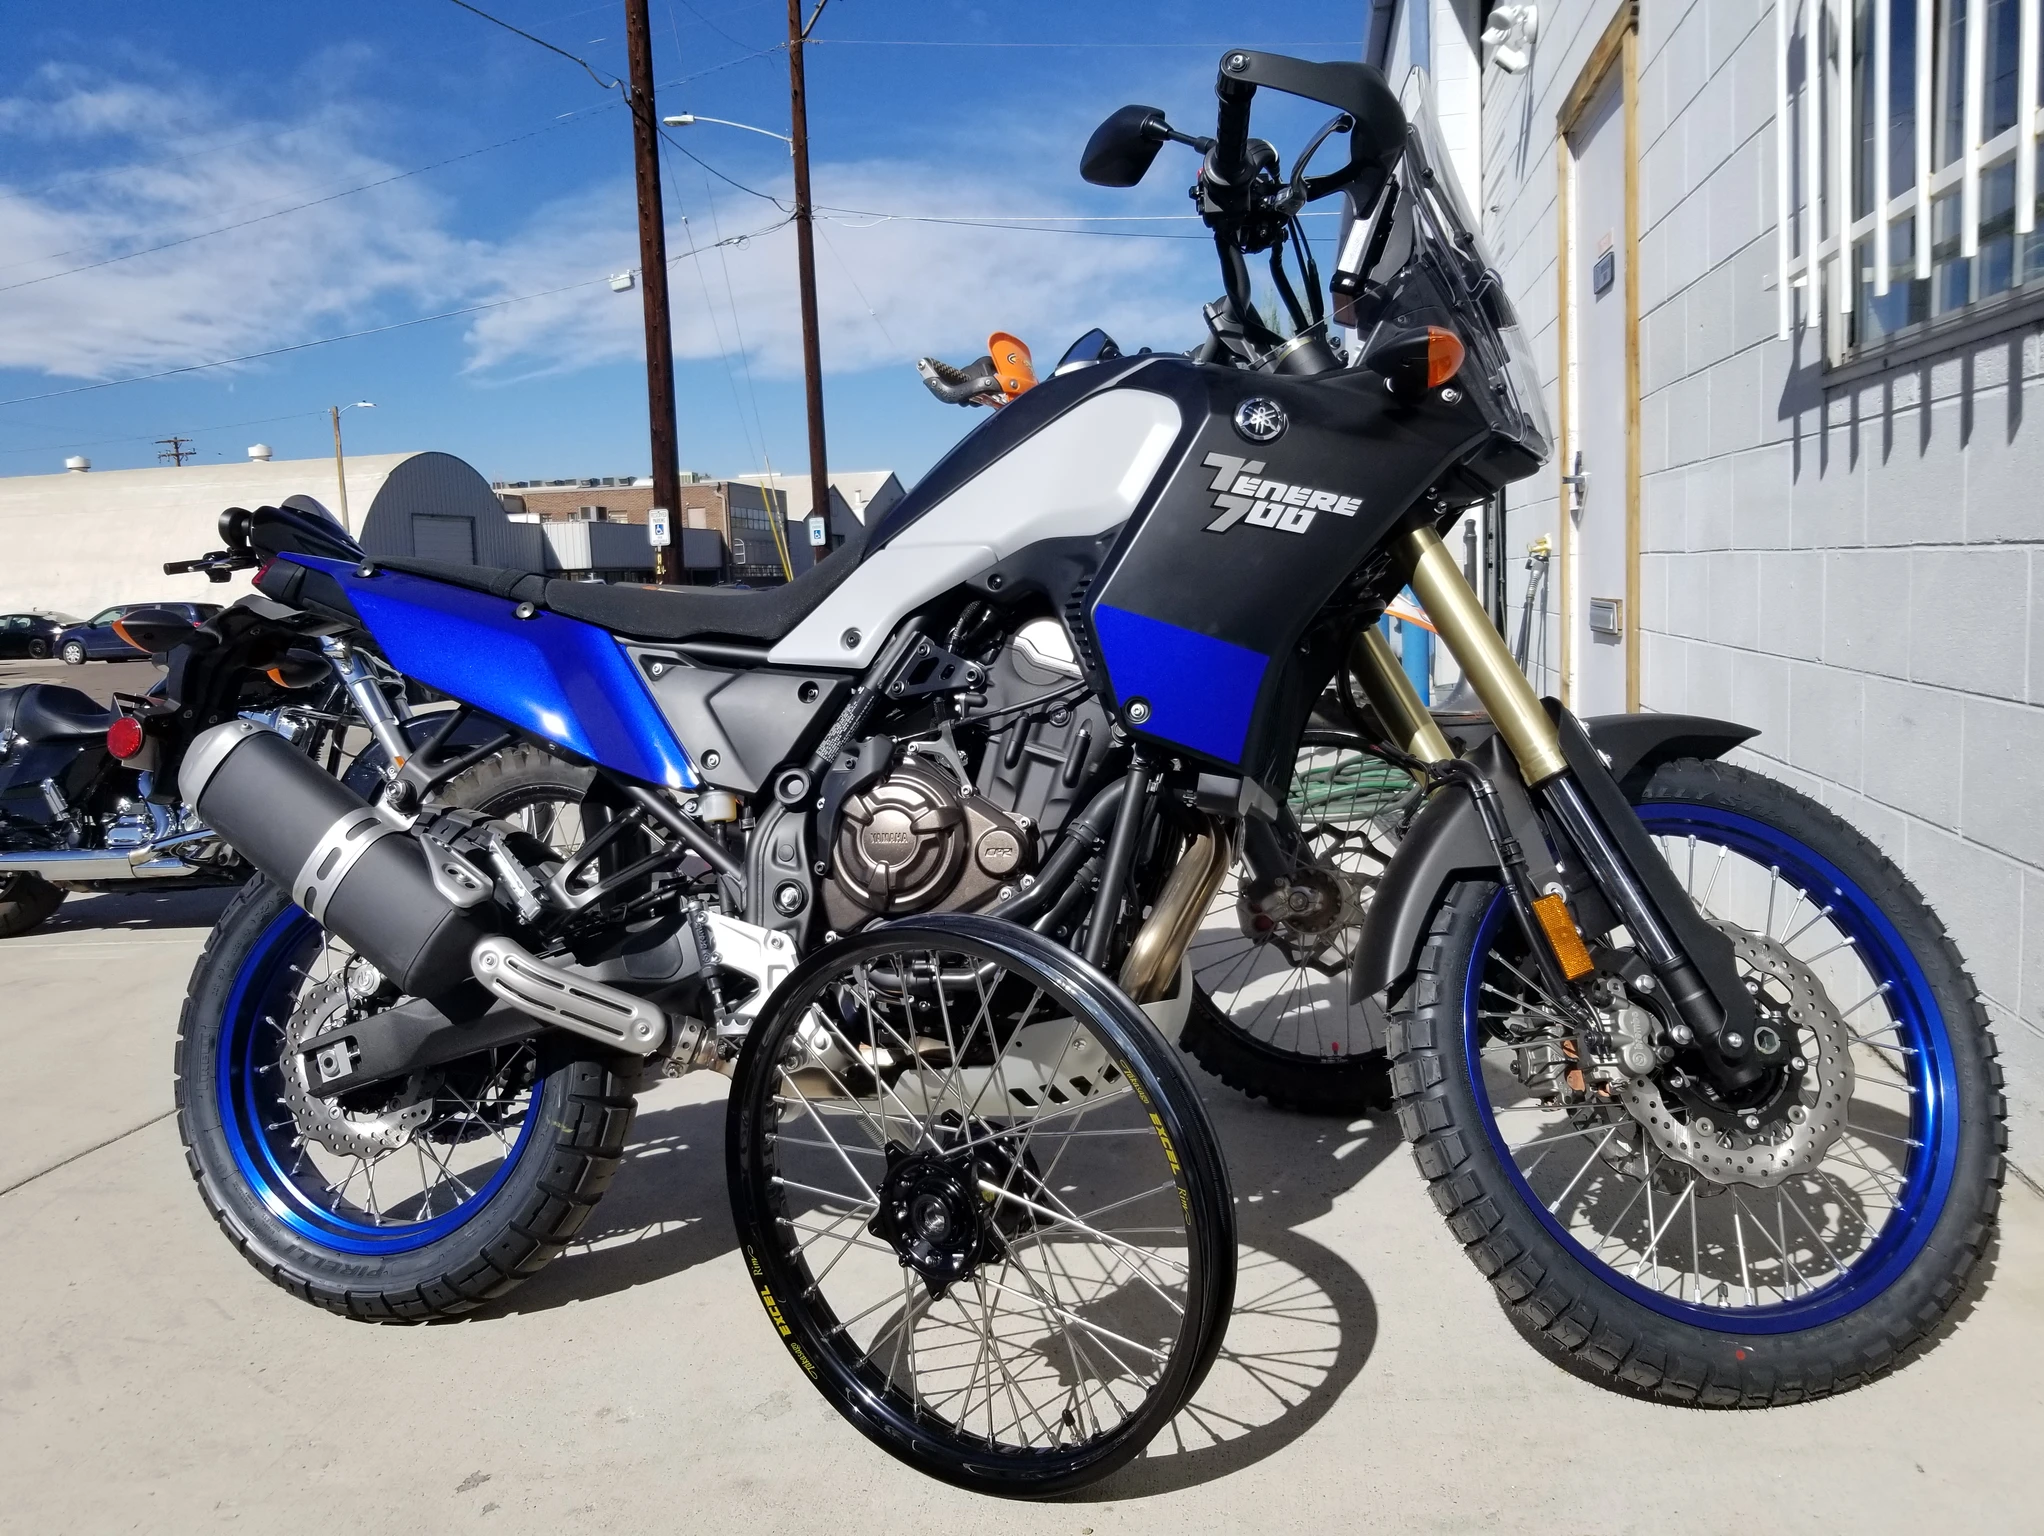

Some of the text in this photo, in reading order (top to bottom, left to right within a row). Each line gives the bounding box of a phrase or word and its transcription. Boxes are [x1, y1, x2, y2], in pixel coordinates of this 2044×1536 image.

[1205, 493, 1317, 535] 700
[870, 832, 908, 844] YAMAHA
[1631, 1011, 1644, 1050] brembo
[1119, 1059, 1192, 1226] Takasago EXCEL Rim
[285, 1244, 386, 1278] PIRELLI
[747, 1245, 818, 1380] Takasago EXCEL Rim
